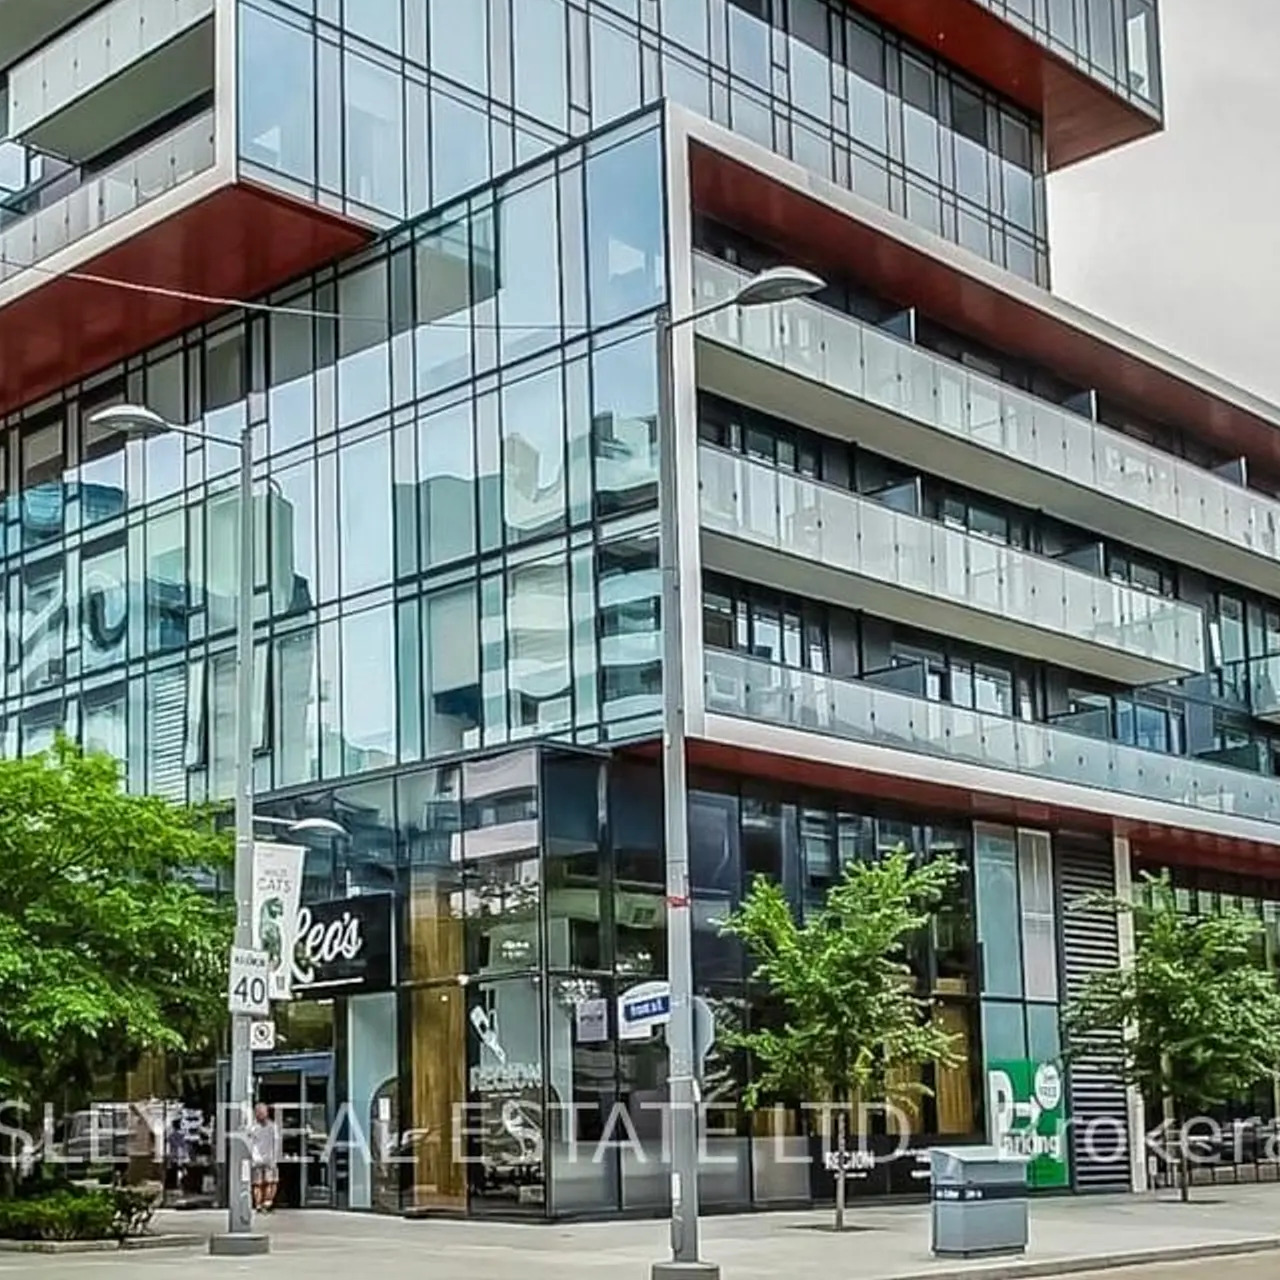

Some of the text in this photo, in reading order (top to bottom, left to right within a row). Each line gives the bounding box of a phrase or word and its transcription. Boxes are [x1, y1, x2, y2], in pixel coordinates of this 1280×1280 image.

[257, 877, 292, 894] CATS
[233, 975, 266, 1006] 40
[825, 1151, 875, 1169] REGION
